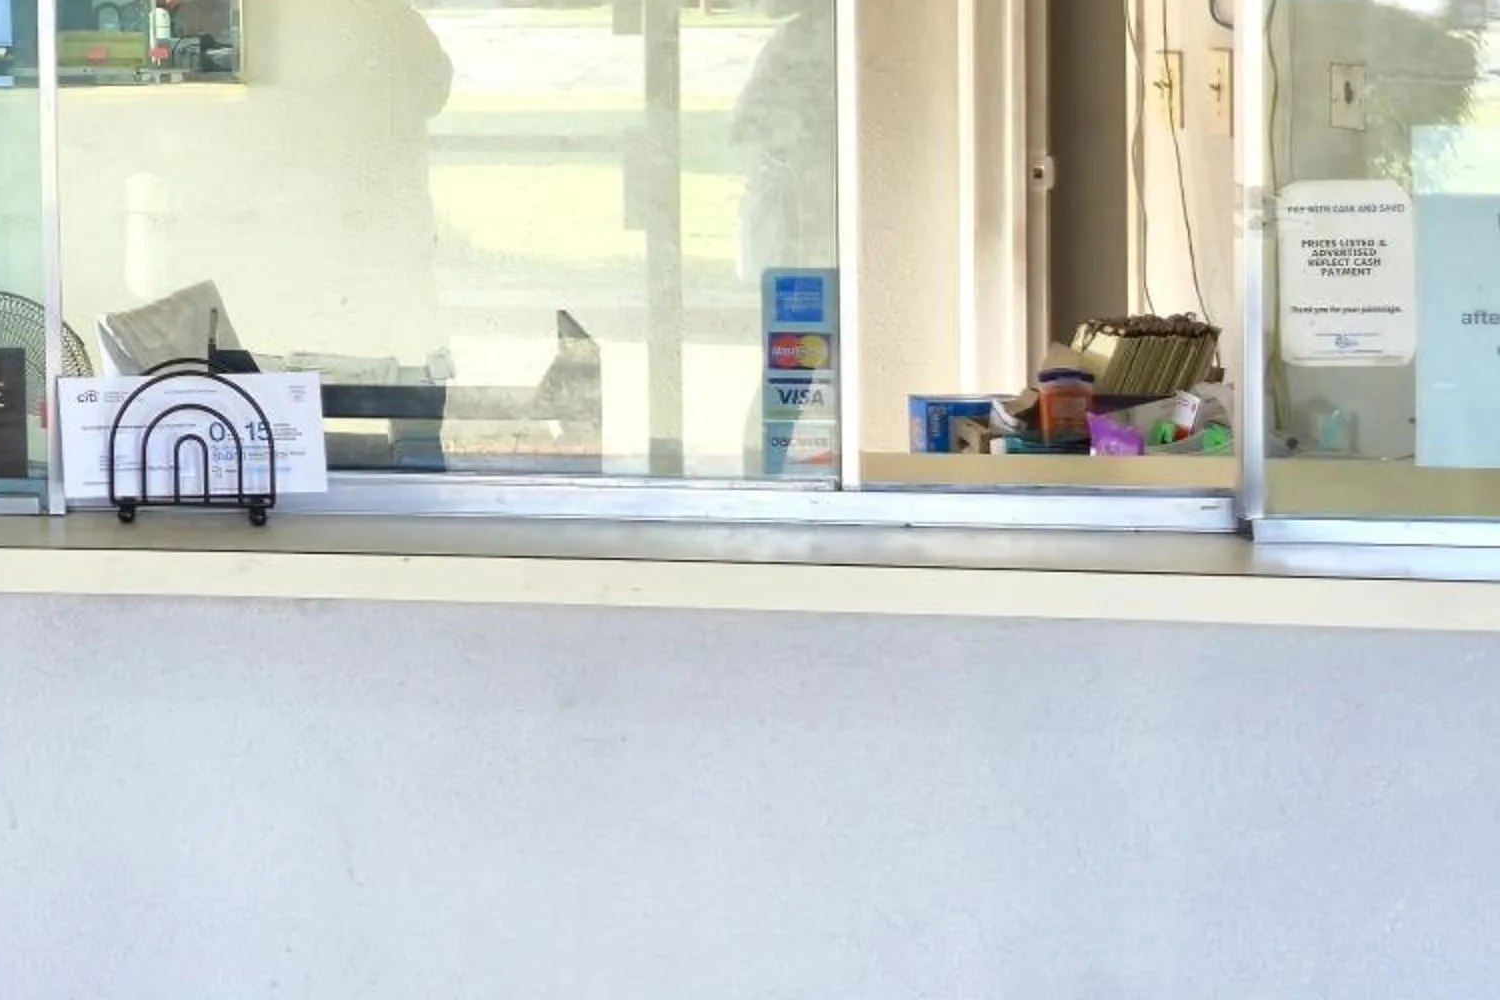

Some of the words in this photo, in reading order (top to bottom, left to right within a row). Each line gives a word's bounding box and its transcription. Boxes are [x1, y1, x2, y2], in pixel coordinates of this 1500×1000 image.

[1301, 239, 1337, 248] PRICES
[1354, 258, 1382, 267] CASH
[1320, 267, 1372, 277] PAYMENT
[776, 388, 825, 407] VISA
